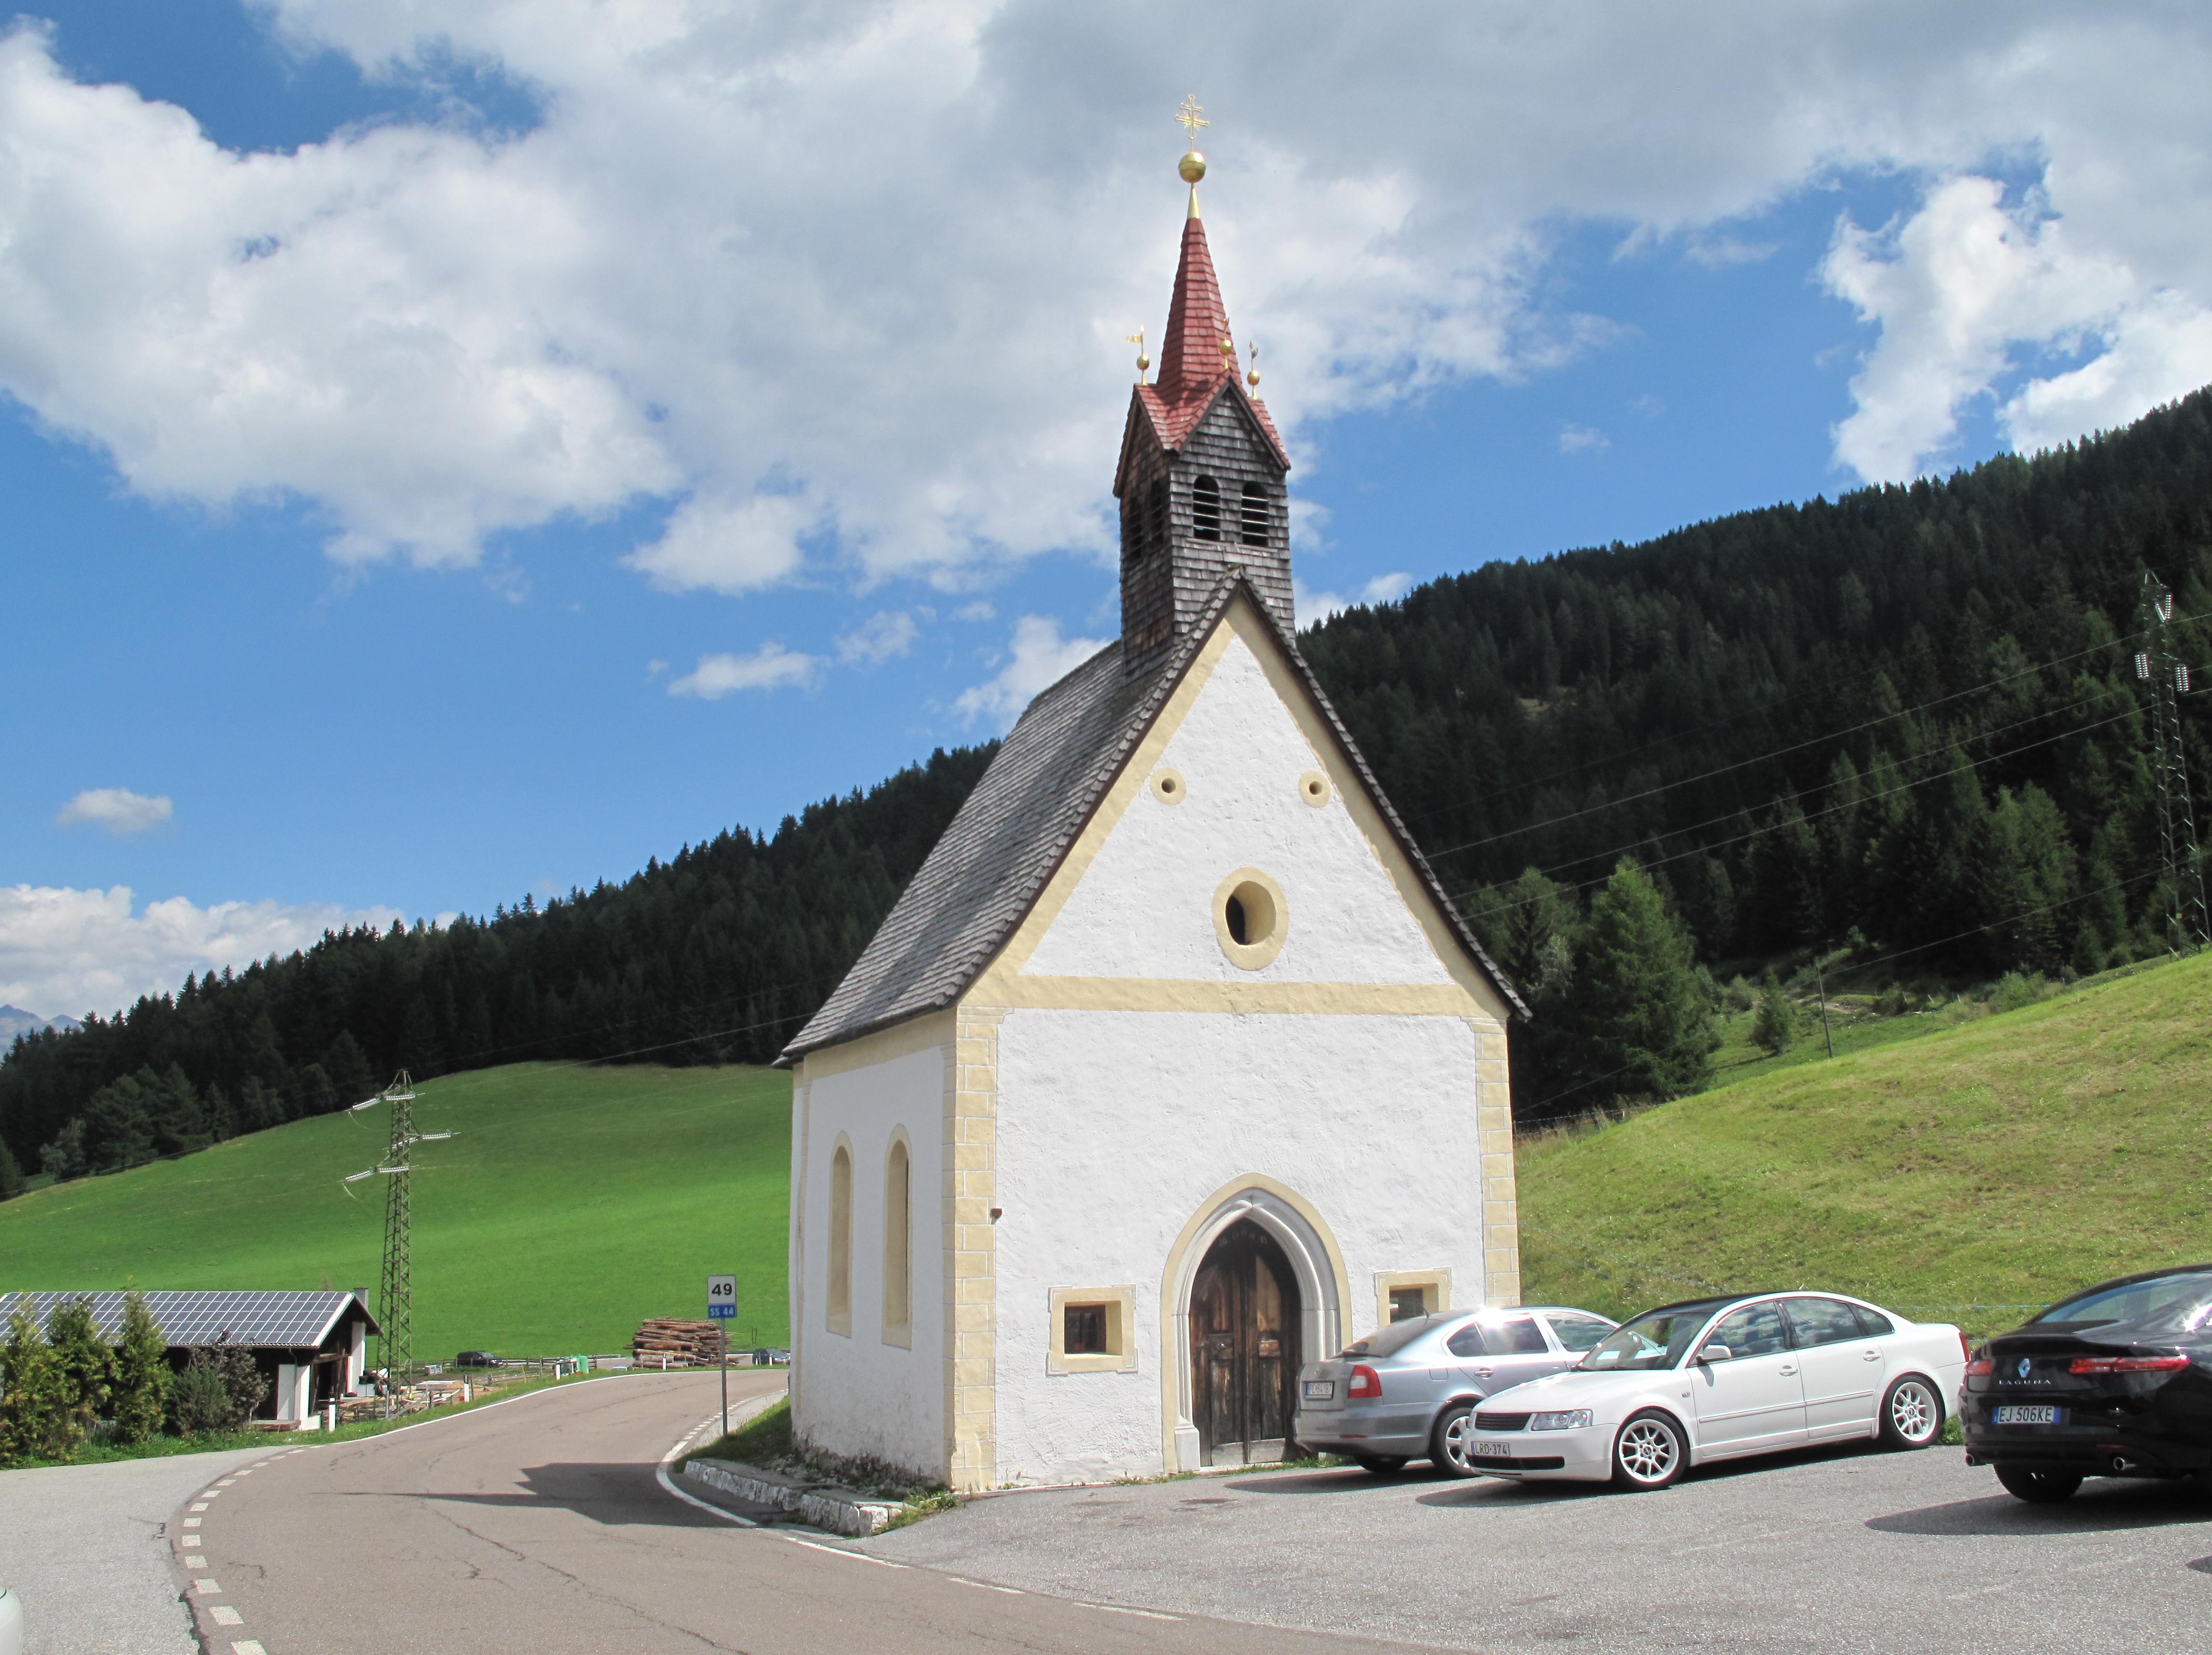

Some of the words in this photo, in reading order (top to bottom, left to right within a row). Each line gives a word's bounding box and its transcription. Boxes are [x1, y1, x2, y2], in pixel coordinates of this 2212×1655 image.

[711, 1283, 733, 1296] 49
[710, 1308, 720, 1316] SS
[723, 1307, 734, 1315] 44
